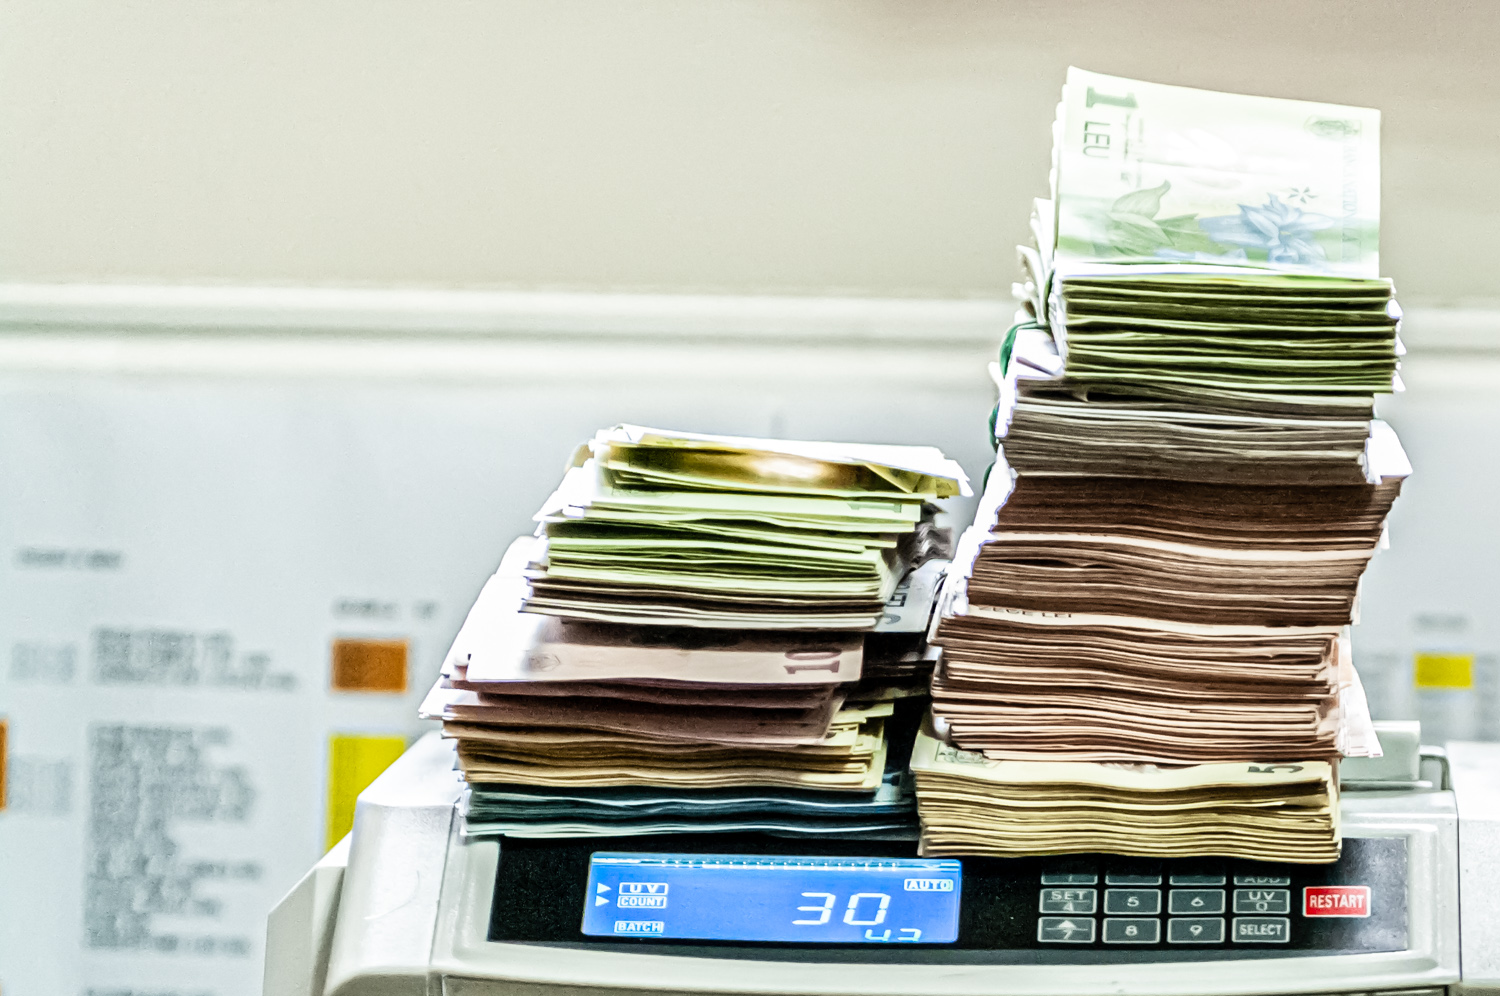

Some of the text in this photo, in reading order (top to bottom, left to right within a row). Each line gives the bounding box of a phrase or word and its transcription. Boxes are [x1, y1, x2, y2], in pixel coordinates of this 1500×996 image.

[1085, 86, 1139, 109] 1
[1083, 121, 1111, 159] LEU
[907, 880, 950, 890] AUTO
[1051, 890, 1088, 900] SET
[1249, 891, 1275, 901] UV
[620, 897, 663, 907] COUNT
[1126, 896, 1140, 907] 5
[1190, 896, 1205, 907] 6
[1309, 894, 1365, 909] RESTART
[791, 892, 892, 926] 30
[617, 922, 661, 932] BATCH
[1124, 925, 1138, 937] 8
[1189, 924, 1203, 937] 9
[1239, 924, 1283, 936] SELECT
